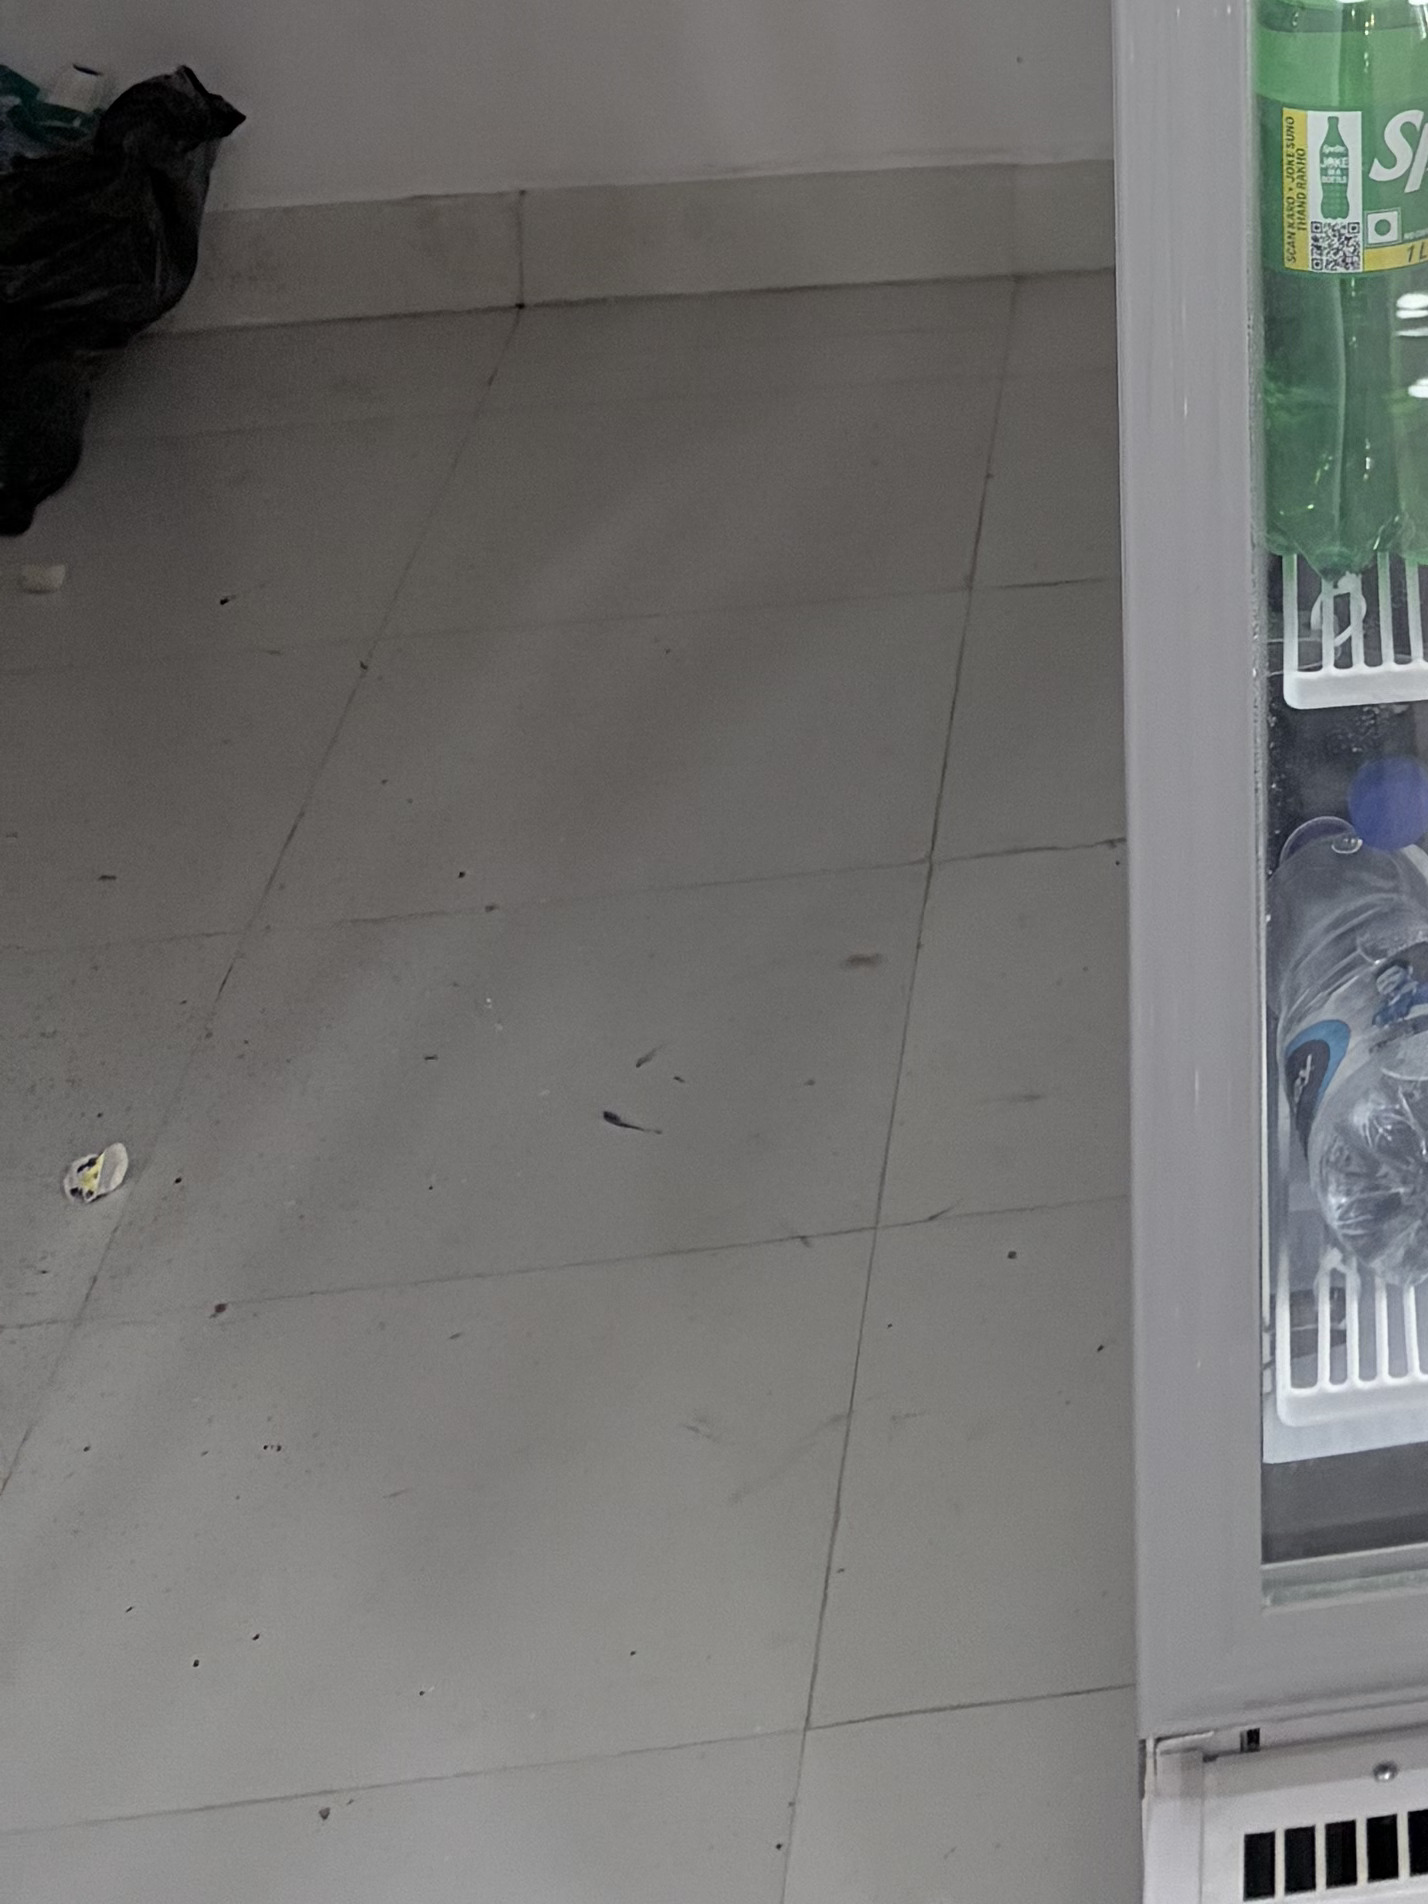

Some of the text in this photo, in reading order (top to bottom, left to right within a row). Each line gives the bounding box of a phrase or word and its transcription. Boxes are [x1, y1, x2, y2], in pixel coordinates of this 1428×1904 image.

[1285, 116, 1296, 263] SCAN KARO JOKE SUNO
[1296, 148, 1307, 231] THAND RAKHO
